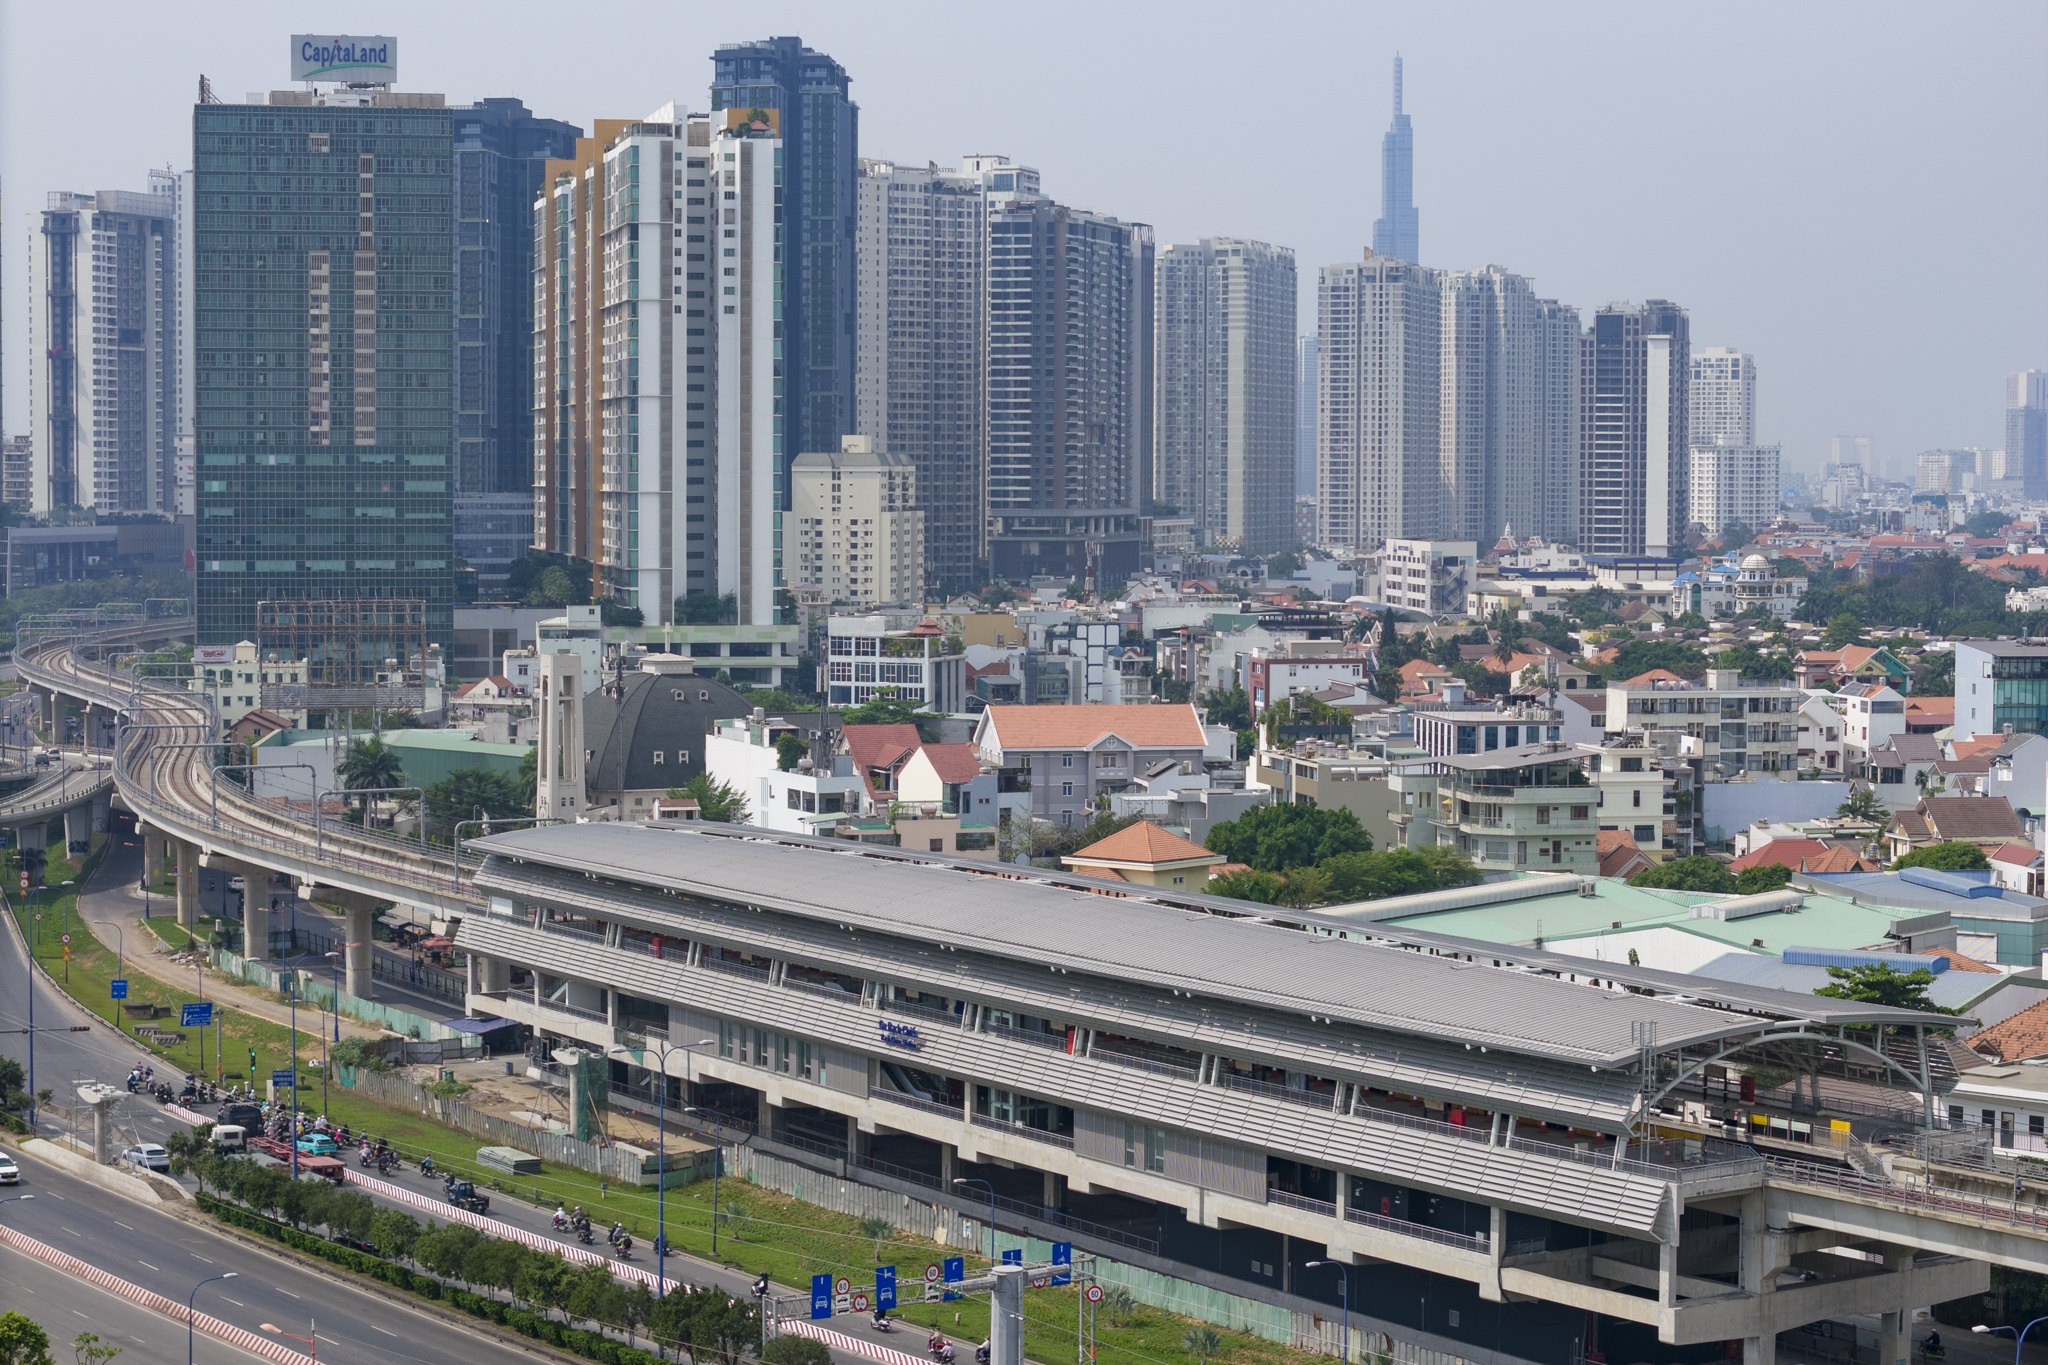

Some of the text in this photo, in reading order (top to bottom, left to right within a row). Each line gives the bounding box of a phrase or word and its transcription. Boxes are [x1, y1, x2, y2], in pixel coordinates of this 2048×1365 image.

[301, 39, 387, 67] CapitaLand
[929, 1269, 937, 1277] 60
[838, 1282, 847, 1291] 80
[1090, 1290, 1099, 1298] 60
